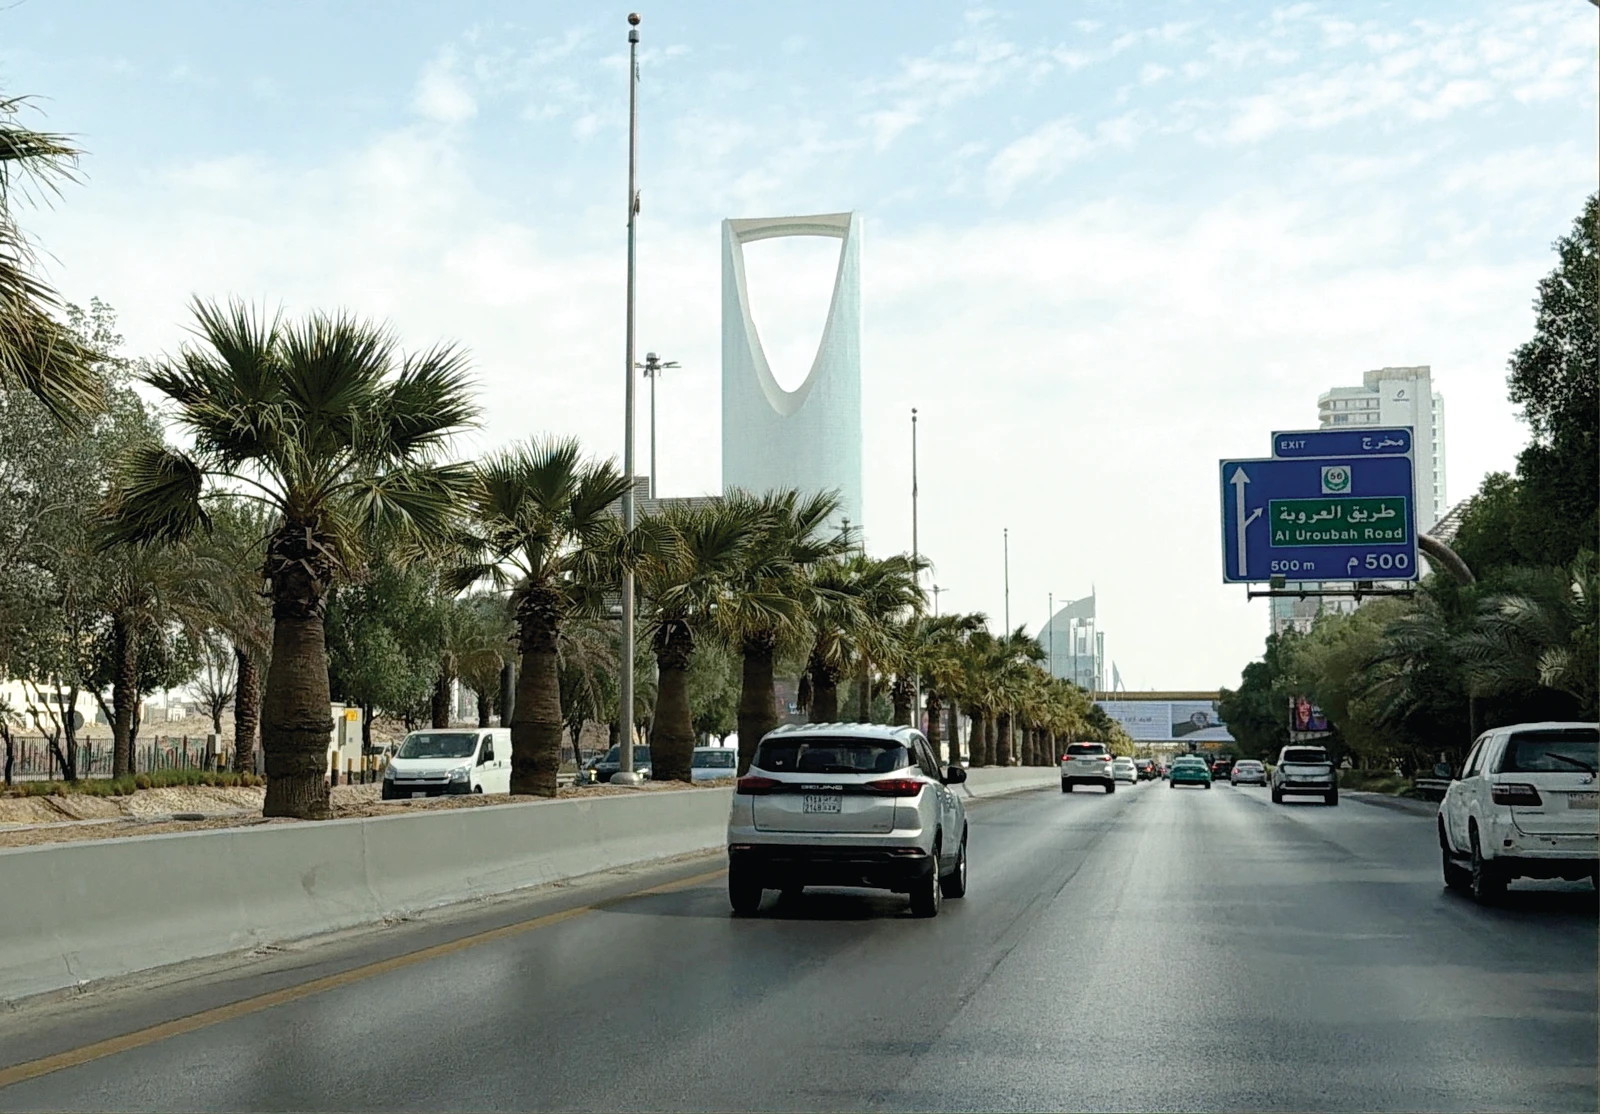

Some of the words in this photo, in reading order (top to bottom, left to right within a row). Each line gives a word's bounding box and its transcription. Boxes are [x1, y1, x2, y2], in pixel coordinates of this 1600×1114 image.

[1281, 440, 1306, 449] EXIT
[1362, 435, 1404, 449] مخرج
[1279, 505, 1341, 524] العروبة
[1347, 504, 1396, 523] طريق
[1275, 530, 1289, 541] Al
[1296, 529, 1358, 541] Uroubah
[1364, 528, 1403, 539] Road
[1271, 560, 1300, 571] 500
[1303, 562, 1315, 570] m
[1347, 557, 1359, 575] م
[1365, 554, 1408, 569] 500
